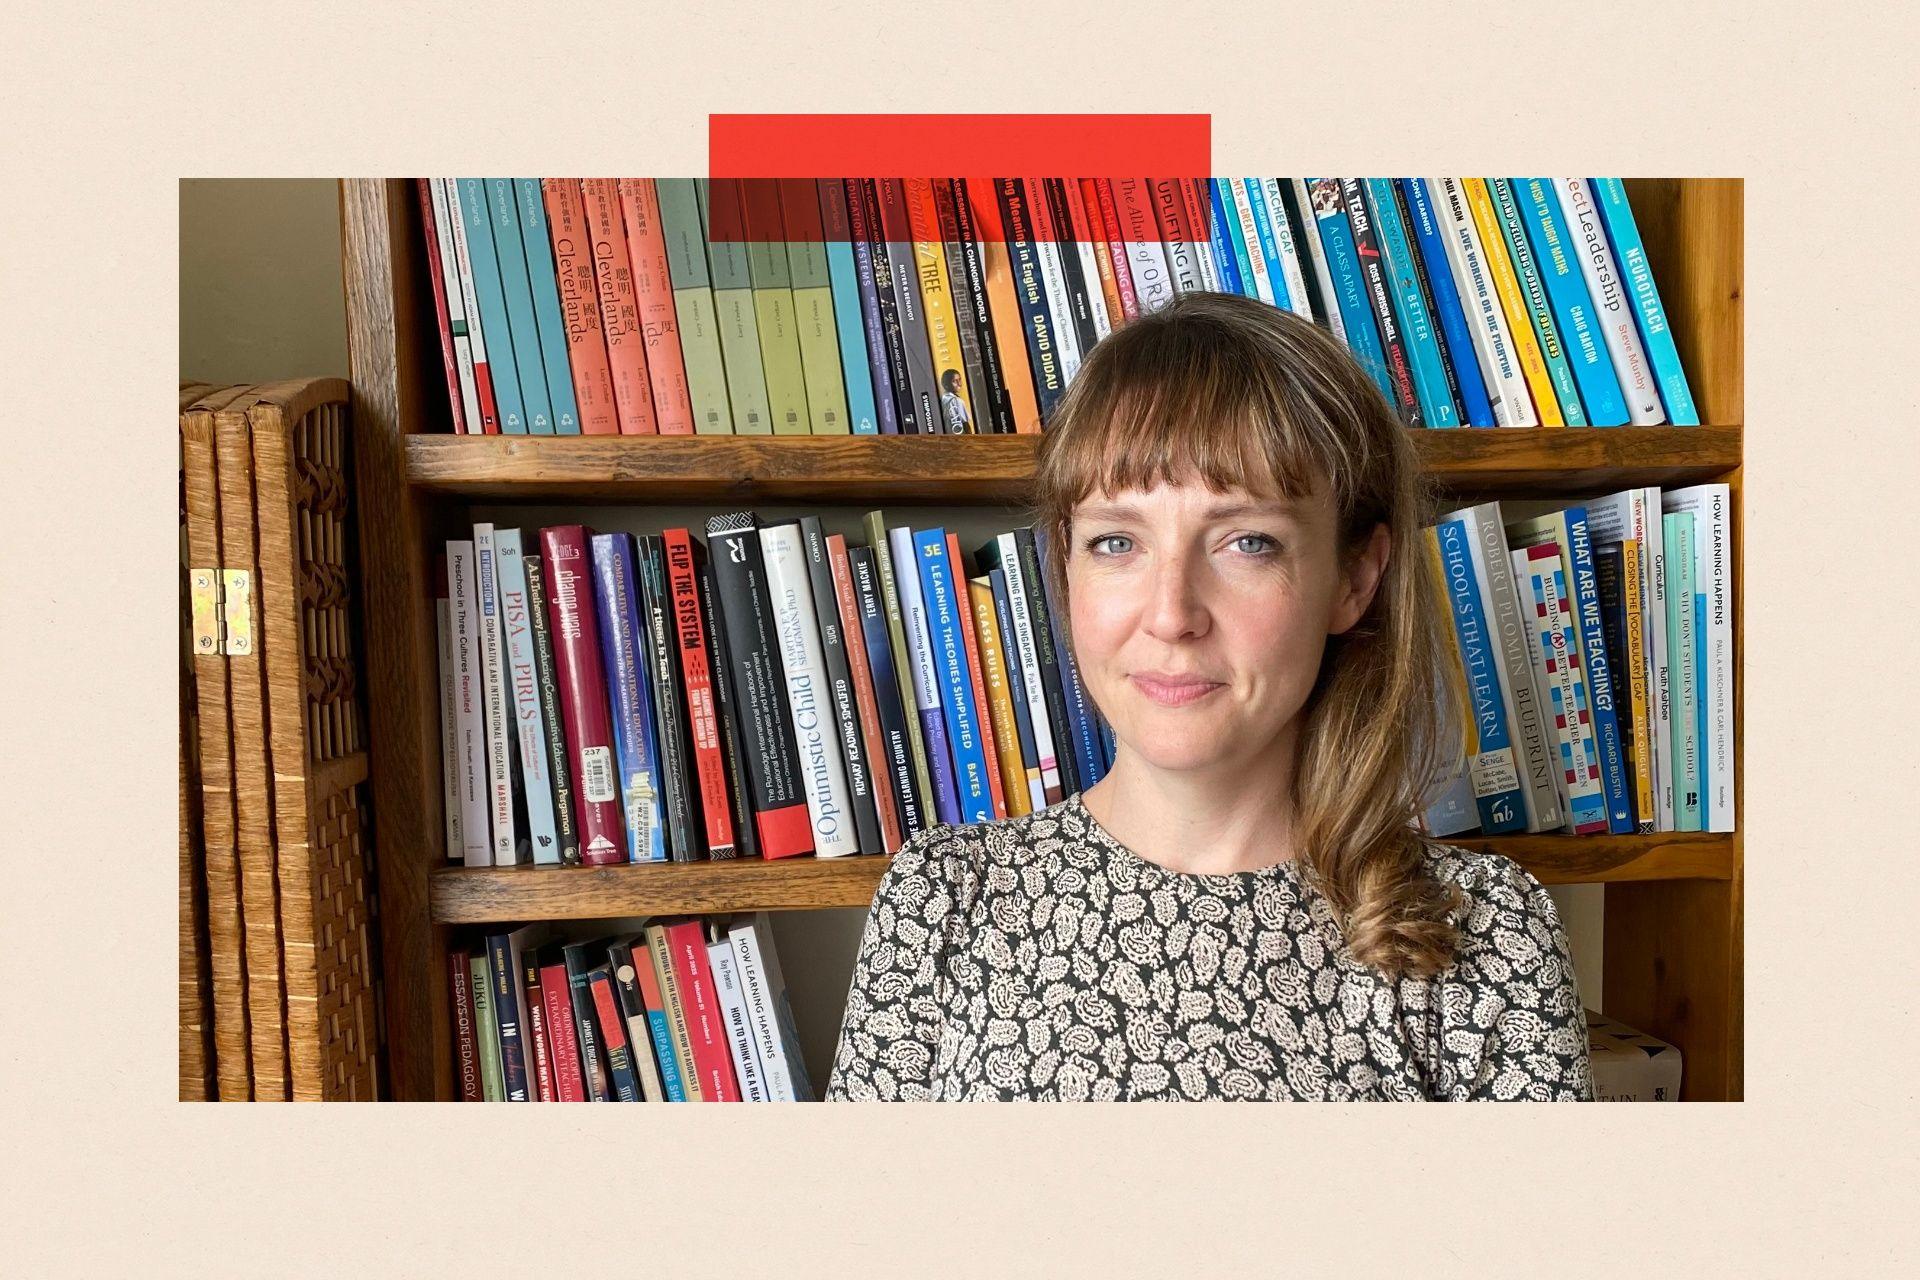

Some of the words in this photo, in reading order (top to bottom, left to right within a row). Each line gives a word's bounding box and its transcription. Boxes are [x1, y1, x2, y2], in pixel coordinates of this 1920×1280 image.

[1007, 196, 1029, 247] Meaning
[1154, 181, 1189, 267] UPLIFTING
[1265, 177, 1286, 228] TEACHER
[1279, 229, 1293, 254] GAP
[1347, 195, 1367, 235] TEACH.
[1416, 198, 1432, 235] LEARNED?
[1448, 194, 1464, 222] MASON
[1501, 201, 1514, 218] AND
[1329, 224, 1339, 234] A
[1458, 227, 1473, 251] LIVE
[1507, 219, 1530, 267] WELLBEING
[1019, 248, 1031, 259] in
[1331, 235, 1350, 271] CLASS
[1573, 209, 1624, 313] Leadership
[556, 237, 587, 342] Cleverlands
[920, 261, 941, 294] TREE
[1020, 262, 1041, 304] English
[1341, 272, 1361, 310] APART
[1466, 252, 1488, 297] WORKING
[1523, 268, 1544, 310] WORKOUT
[1624, 247, 1665, 333] NEUROTEACH
[595, 240, 626, 346] Cleverlands
[1480, 298, 1492, 312] OR
[1032, 314, 1050, 350] DAVID
[1406, 293, 1427, 341] BETTER
[1485, 313, 1498, 331] DIE
[1536, 311, 1550, 329] FOR
[1569, 304, 1588, 331] CRAIG
[1491, 332, 1513, 379] FIGHTING
[1542, 329, 1559, 358] TEENS
[1577, 330, 1599, 364] BARTON
[1618, 323, 1635, 352] Steve
[1040, 352, 1058, 390] DIDAU
[1625, 353, 1647, 391] Munby
[1711, 494, 1720, 520] HOW
[669, 543, 689, 569] FLIP
[809, 532, 821, 562] CORWIN
[877, 539, 890, 571] EDUCATION
[1570, 520, 1592, 566] WHAT
[1712, 523, 1721, 575] LEARNING
[452, 555, 464, 597] Preschool
[611, 553, 628, 616] COMPARATIVE
[673, 572, 693, 596] THE
[857, 560, 871, 591] MACKIE
[1005, 553, 1020, 594] LEARNING
[1440, 525, 1474, 614] SCHOOLS
[1577, 568, 1596, 600] ARE
[1654, 554, 1663, 600] Curriculum
[456, 599, 464, 607] in
[504, 589, 527, 636] PISA
[863, 592, 876, 617] TERRY
[885, 586, 897, 611] FEDERAL
[890, 612, 898, 620] UK
[1013, 596, 1025, 619] FROM
[1582, 600, 1600, 625] WE
[1680, 591, 1688, 614] WHY
[1713, 578, 1722, 624] HAPPENS
[457, 610, 466, 634] Three
[619, 617, 630, 636] AND
[677, 598, 701, 649] SYSTEM
[825, 624, 837, 644] SUCH
[910, 607, 924, 649] Reinventing
[974, 603, 994, 643] CLASS
[1681, 619, 1690, 648] DON'T
[459, 637, 468, 671] Cultures
[510, 642, 522, 658] and
[919, 650, 927, 662] the
[930, 564, 950, 624] LEARNING
[942, 627, 960, 683] THEORIES
[952, 685, 972, 749] SIMPLIFIED
[1018, 621, 1033, 668] SINGAPORE
[1460, 616, 1486, 670] THAT
[1480, 519, 1509, 596] ROBERT
[1498, 600, 1526, 675] PLOMIN
[1515, 687, 1550, 792] BLUEPRINT
[1542, 576, 1561, 630] BUILDING
[1555, 649, 1571, 690] BETTER
[1563, 694, 1581, 744] TEACHER
[622, 638, 640, 710] INTERNATIONAL
[743, 660, 751, 668] of
[982, 647, 1003, 688] RULES
[1584, 626, 1613, 712] TEACHING?
[1659, 667, 1667, 685] Ruth
[1682, 651, 1692, 706] STUDENTS
[461, 675, 471, 712] Revisited
[513, 663, 537, 720] PIRLS
[745, 669, 758, 706] Handbook
[790, 673, 818, 723] Child
[835, 678, 852, 720] SIMPLIFIED
[921, 663, 934, 703] Curriculum
[1471, 672, 1500, 738] LEARN
[1660, 688, 1669, 720] Ashbee
[631, 712, 647, 763] EDUCATION
[752, 707, 766, 750] International
[842, 721, 859, 760] READING
[1602, 723, 1618, 763] RICHARD
[1636, 715, 1644, 737] ALEX
[584, 748, 601, 756] 237
[890, 729, 905, 764] COUNTRY
[1637, 740, 1647, 777] QUIGLEY
[1685, 735, 1695, 780] SCHOOL?
[760, 751, 773, 787] Routledge
[802, 729, 842, 837] Optimistic
[850, 762, 866, 796] PRIMARY
[897, 765, 912, 803] LEARNING
[967, 762, 981, 796] BATES
[1608, 764, 1623, 798] BUSTIN
[496, 783, 509, 824] MARSHALL
[767, 788, 775, 802] The
[904, 804, 916, 824] SLOW
[656, 935, 664, 947] THE
[738, 937, 751, 962] HOW
[658, 947, 671, 974] TROUBLE
[453, 973, 468, 1014] ESSAYS
[472, 973, 487, 1010] JUKU
[665, 975, 675, 992] WITH
[744, 964, 764, 1013] LEARNING
[532, 1006, 541, 1032] WHAT
[669, 992, 681, 1018] ENGLISH
[730, 1006, 742, 1025] HOW
[458, 1017, 469, 1034] ON
[547, 990, 568, 1059] EXTRAORDINARY
[560, 1007, 576, 1049] ORDINARY
[675, 1019, 684, 1032] AND
[678, 1032, 688, 1047] HOW
[735, 1026, 745, 1037] TO
[757, 1015, 775, 1059] HAPPENS
[459, 1037, 476, 1097] PEDAGOGY
[535, 1033, 545, 1065] WORKS
[649, 1017, 679, 1081] SURPASSING
[682, 1048, 690, 1056] TO
[737, 1038, 751, 1061] THINK
[539, 1066, 547, 1086] MAY
[684, 1057, 697, 1084] ADDRESS
[712, 1069, 722, 1089] British
[743, 1062, 755, 1078] LIKE
